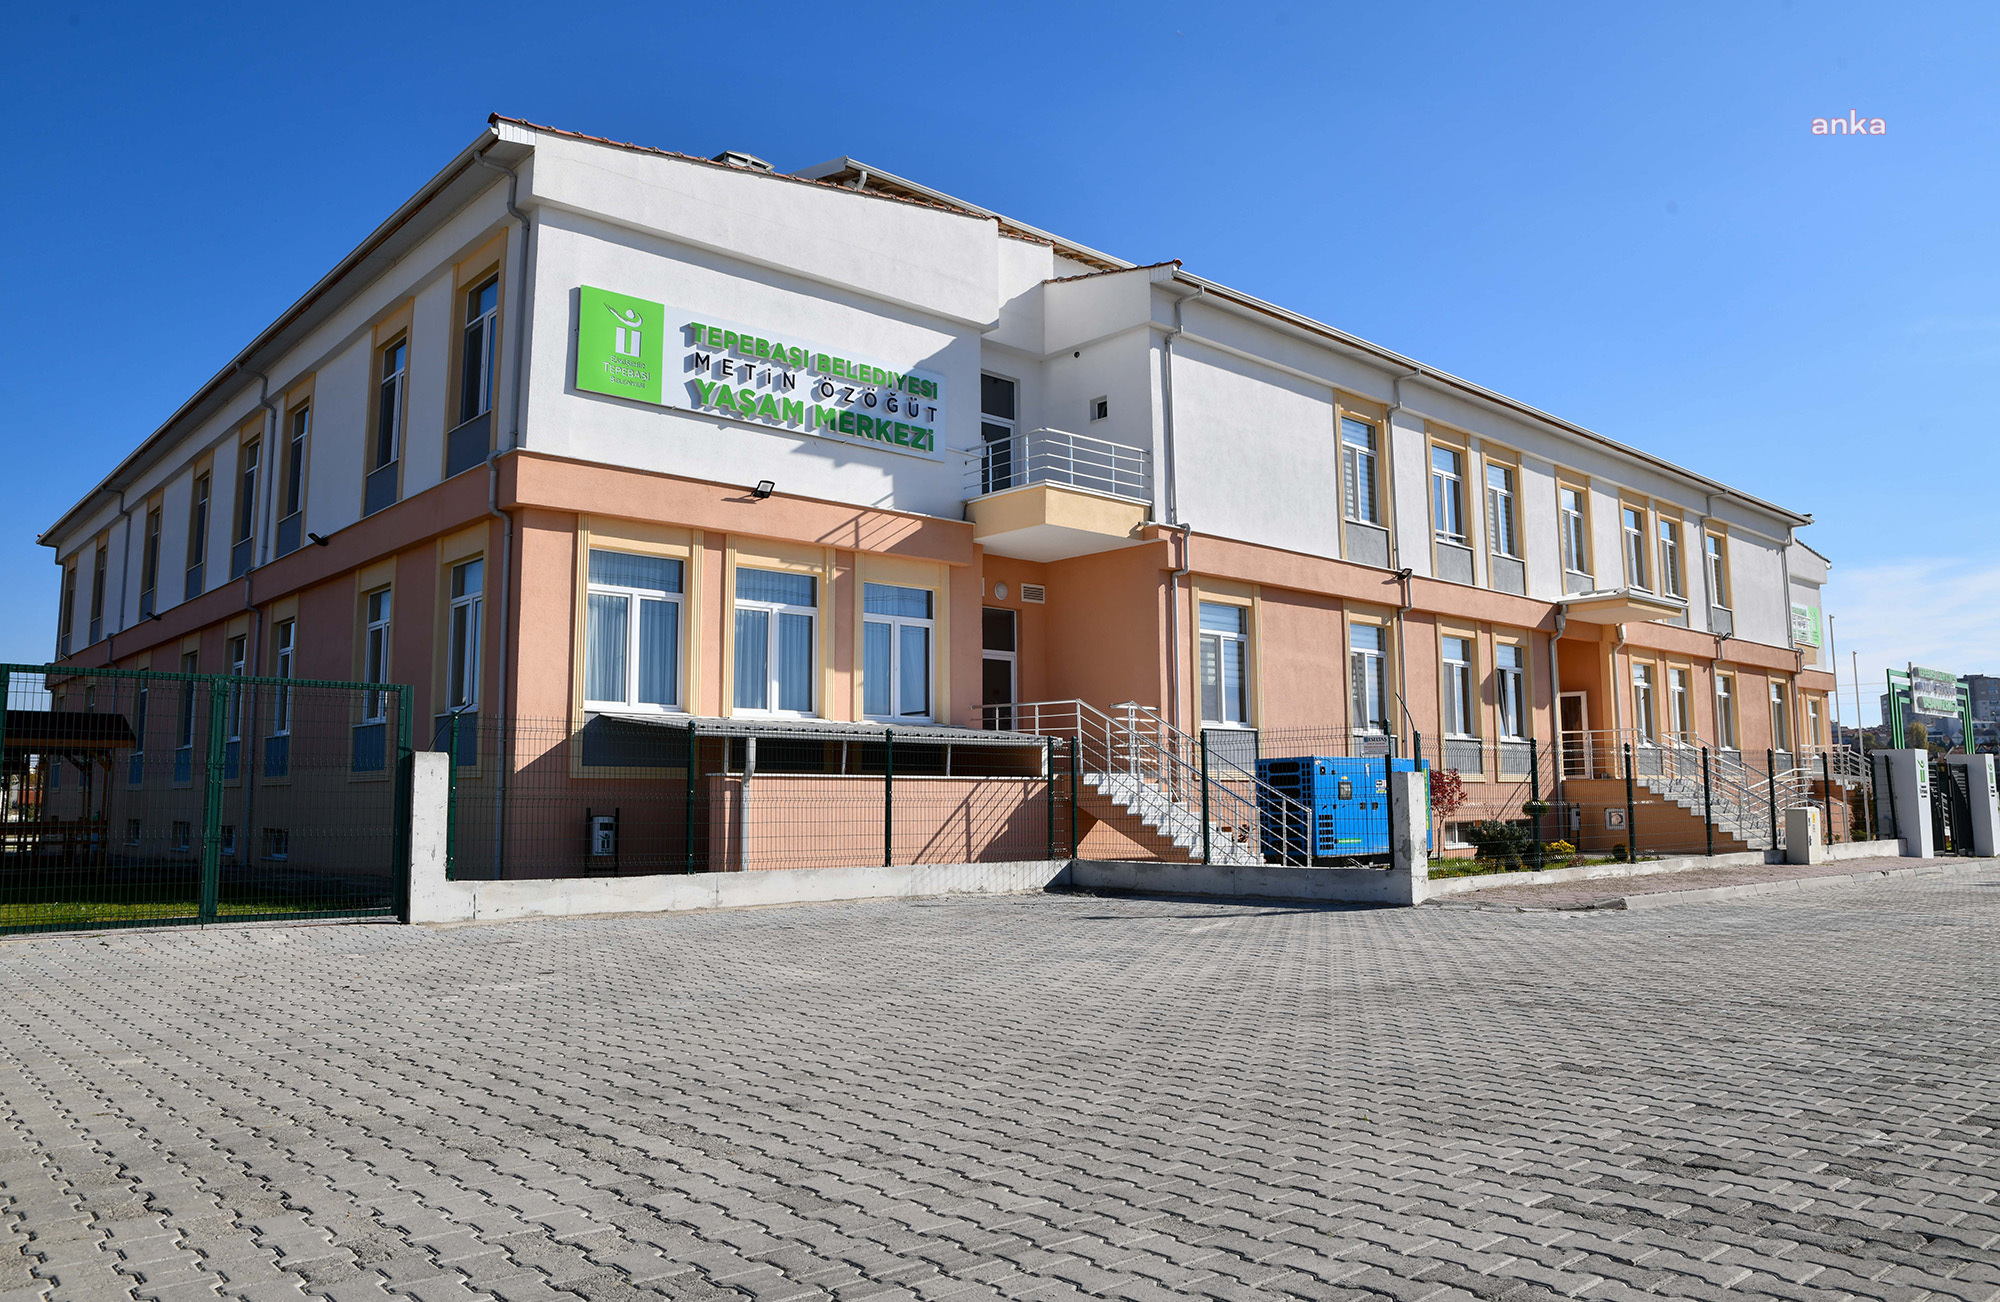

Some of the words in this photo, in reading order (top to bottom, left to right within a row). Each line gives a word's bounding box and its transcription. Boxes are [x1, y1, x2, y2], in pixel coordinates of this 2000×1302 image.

[690, 322, 809, 369] TEPEBAŞI
[603, 361, 651, 381] TEPEBAŞI
[694, 378, 804, 425] YAŞAM
[819, 372, 938, 422] ÖZÖĞÜT
